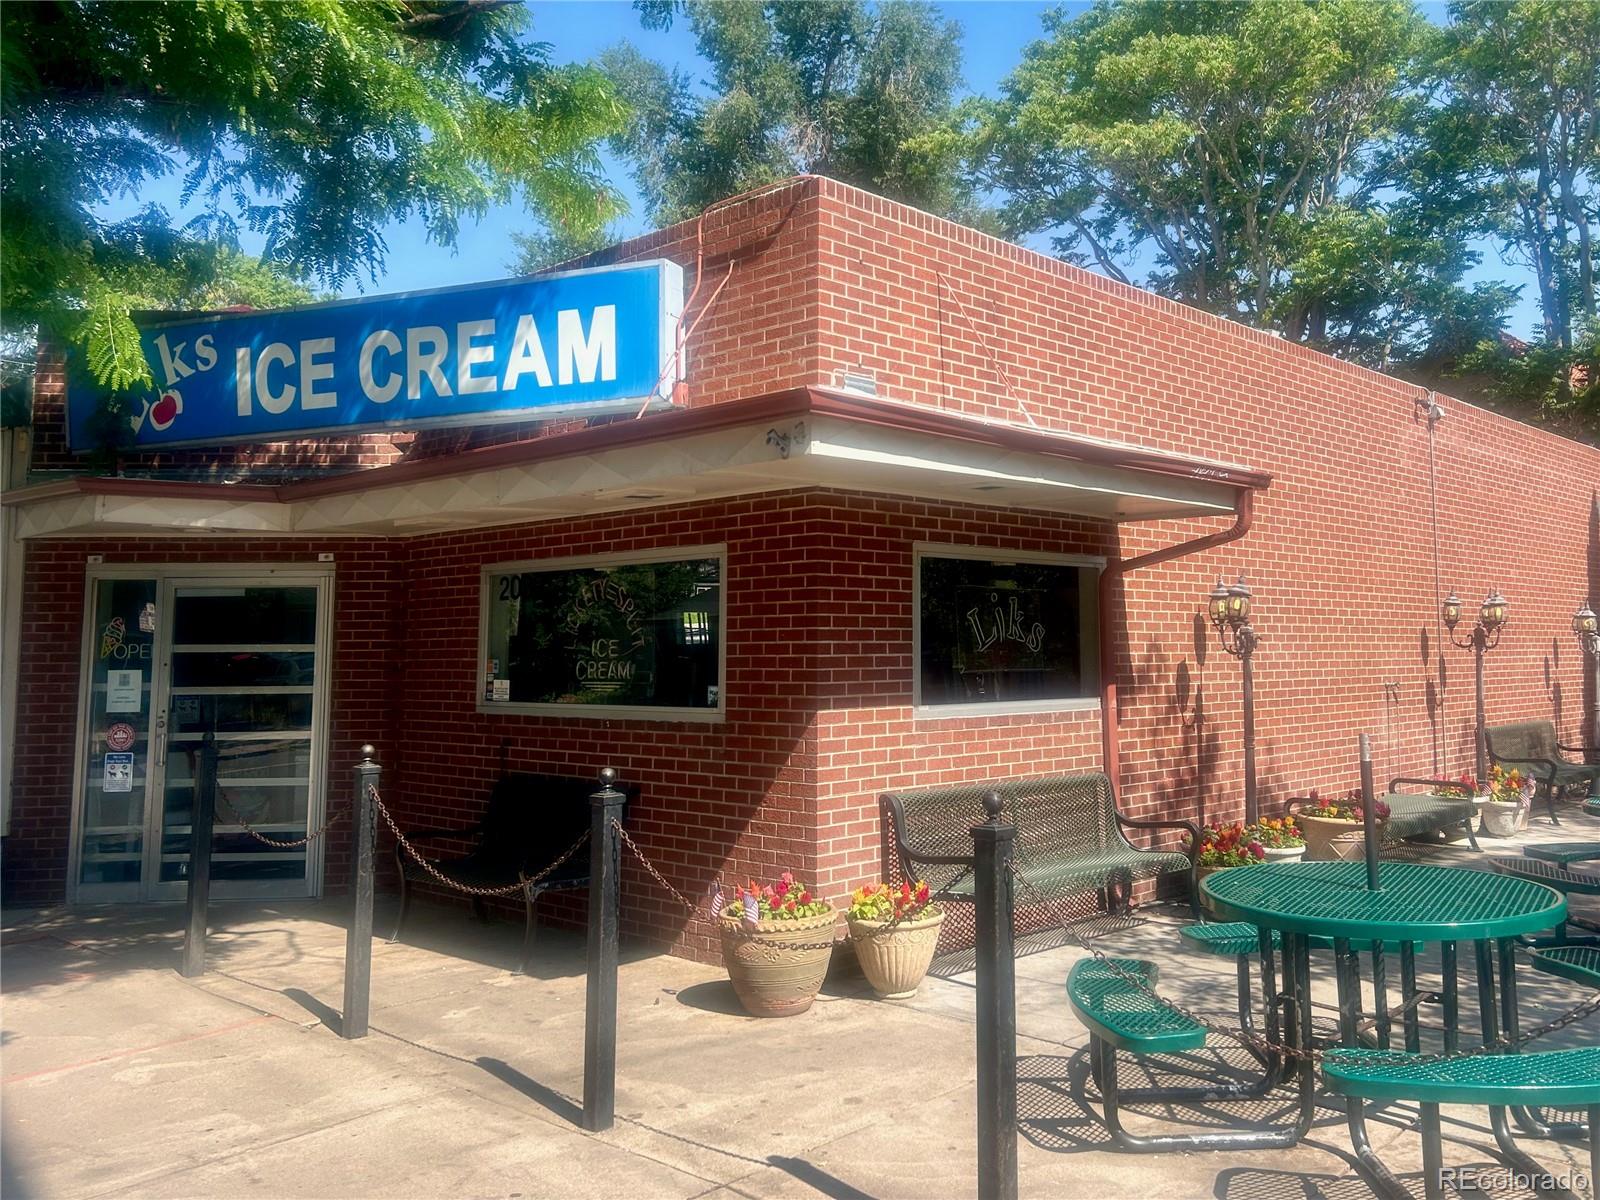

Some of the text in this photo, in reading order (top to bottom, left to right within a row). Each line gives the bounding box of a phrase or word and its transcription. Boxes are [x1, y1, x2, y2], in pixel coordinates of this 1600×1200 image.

[235, 336, 338, 418] ICE
[358, 304, 618, 402] CREAM
[966, 592, 1046, 652] Liks
[591, 638, 621, 658] ICE
[575, 659, 632, 681] CREAM
